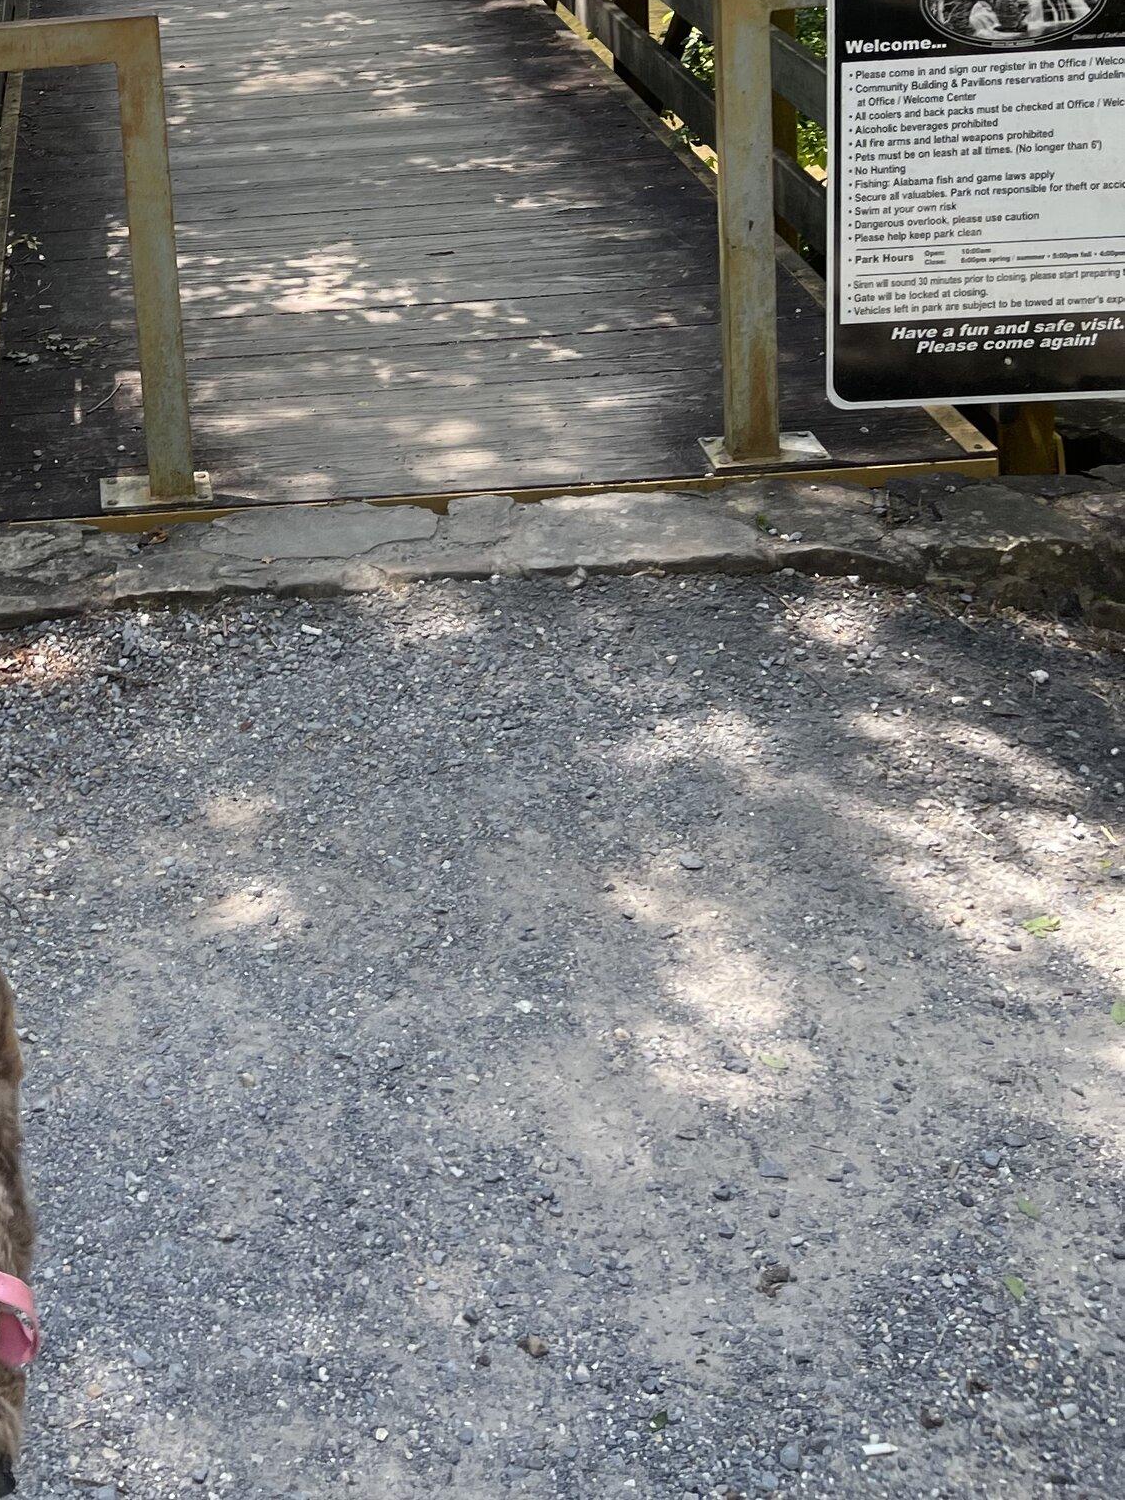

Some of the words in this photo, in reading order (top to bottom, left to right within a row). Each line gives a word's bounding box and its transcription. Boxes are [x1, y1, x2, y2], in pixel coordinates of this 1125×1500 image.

[845, 39, 947, 54] Welcome...
[855, 69, 886, 80] Please
[889, 69, 915, 78] come
[917, 66, 926, 76] in
[928, 65, 946, 76] and
[949, 64, 969, 77] sign
[971, 64, 988, 74] our
[989, 61, 1026, 74] register
[1028, 60, 1038, 70] in
[1039, 59, 1055, 70] the
[1057, 57, 1087, 69] Office
[855, 81, 909, 94] Community
[911, 79, 949, 91] Building
[951, 78, 958, 89] &
[961, 76, 1003, 88] Pavilions
[1005, 73, 1065, 85] reservations
[1067, 70, 1086, 82] and
[857, 97, 866, 107] at
[868, 95, 896, 107] Office
[903, 94, 944, 104] Welcome
[946, 91, 977, 102] Center
[854, 111, 867, 122] All
[868, 109, 902, 121] coolers
[904, 108, 922, 118] and
[923, 106, 946, 117] back
[947, 105, 974, 118] packs
[976, 104, 1000, 115] must
[1001, 103, 1013, 113] be
[1015, 100, 1054, 112] checked
[1055, 100, 1065, 110] at
[1067, 98, 1095, 109] Office
[855, 123, 898, 135] Alcoholic
[900, 122, 949, 133] beverages
[951, 117, 999, 132] prohibited
[854, 138, 868, 148] All
[869, 137, 885, 148] fire
[887, 137, 912, 147] arms
[913, 134, 932, 145] and
[933, 133, 960, 144] lethal
[961, 132, 1004, 144] weapons
[1006, 128, 1054, 142] prohibited
[854, 152, 876, 162] Pets
[878, 150, 902, 161] must
[903, 149, 916, 160] be
[918, 150, 930, 159] on
[933, 147, 958, 158] leash
[960, 147, 970, 156] at
[972, 145, 983, 156] all
[985, 145, 1013, 155] times.
[1015, 143, 1032, 155] (No
[1034, 142, 1065, 154] longer
[1067, 141, 1089, 151] than
[854, 165, 868, 176] No
[870, 164, 906, 176] Hunting
[893, 176, 934, 187] Alabama
[936, 174, 954, 185] fish
[956, 173, 974, 184] and
[976, 173, 1003, 185] game
[1005, 171, 1027, 181] laws
[1029, 169, 1056, 182] apply
[854, 192, 887, 203] Secure
[889, 190, 900, 201] all
[901, 189, 948, 200] valuables.
[950, 187, 972, 197] Park
[974, 186, 990, 196] not
[992, 183, 1047, 197] responsible
[1049, 183, 1063, 192] for
[1065, 181, 1088, 191] theft
[1089, 182, 1101, 191] or
[855, 205, 880, 216] Swim
[882, 205, 892, 215] at
[893, 205, 915, 216] your
[917, 204, 937, 213] own
[939, 201, 957, 211] risk
[854, 219, 905, 231] Dangerous
[952, 214, 983, 226] please
[985, 214, 1003, 223] use
[1005, 211, 1040, 222] caution
[854, 233, 885, 243] Please
[887, 231, 907, 242] help
[909, 230, 932, 241] keep
[933, 228, 955, 241] park
[957, 227, 982, 237] clean
[855, 254, 880, 265] Park
[882, 253, 914, 263] Hours
[853, 279, 874, 290] Siren
[875, 278, 889, 288] will
[891, 277, 917, 288] sound
[918, 276, 928, 286] 30
[930, 276, 963, 286] minutes
[964, 273, 984, 286] prior
[985, 273, 995, 283] to
[1029, 271, 1057, 283] please
[1059, 269, 1079, 279] start
[1081, 267, 1121, 279] preparing
[853, 293, 876, 303] Gate
[877, 291, 893, 301] will
[895, 291, 907, 301] be
[909, 288, 940, 300] locked
[941, 289, 951, 298] at
[953, 287, 989, 299] closing.
[853, 305, 891, 316] Vehicles
[894, 303, 909, 314] left
[911, 303, 920, 313] in
[921, 302, 943, 314] park
[945, 303, 960, 311] are
[962, 300, 996, 312] subject
[998, 299, 1008, 308] to
[1010, 298, 1022, 308] be
[1024, 297, 1054, 307] towed
[1055, 297, 1065, 306] at
[1067, 295, 1104, 306] owner's
[891, 326, 938, 340] Have
[942, 327, 955, 338] a
[959, 323, 989, 337] fun
[994, 320, 1030, 335] and
[1033, 319, 1075, 333] safe
[1080, 317, 1124, 331] visit.
[916, 340, 978, 354] Please
[983, 338, 1035, 351] come
[1039, 333, 1098, 351] again!
